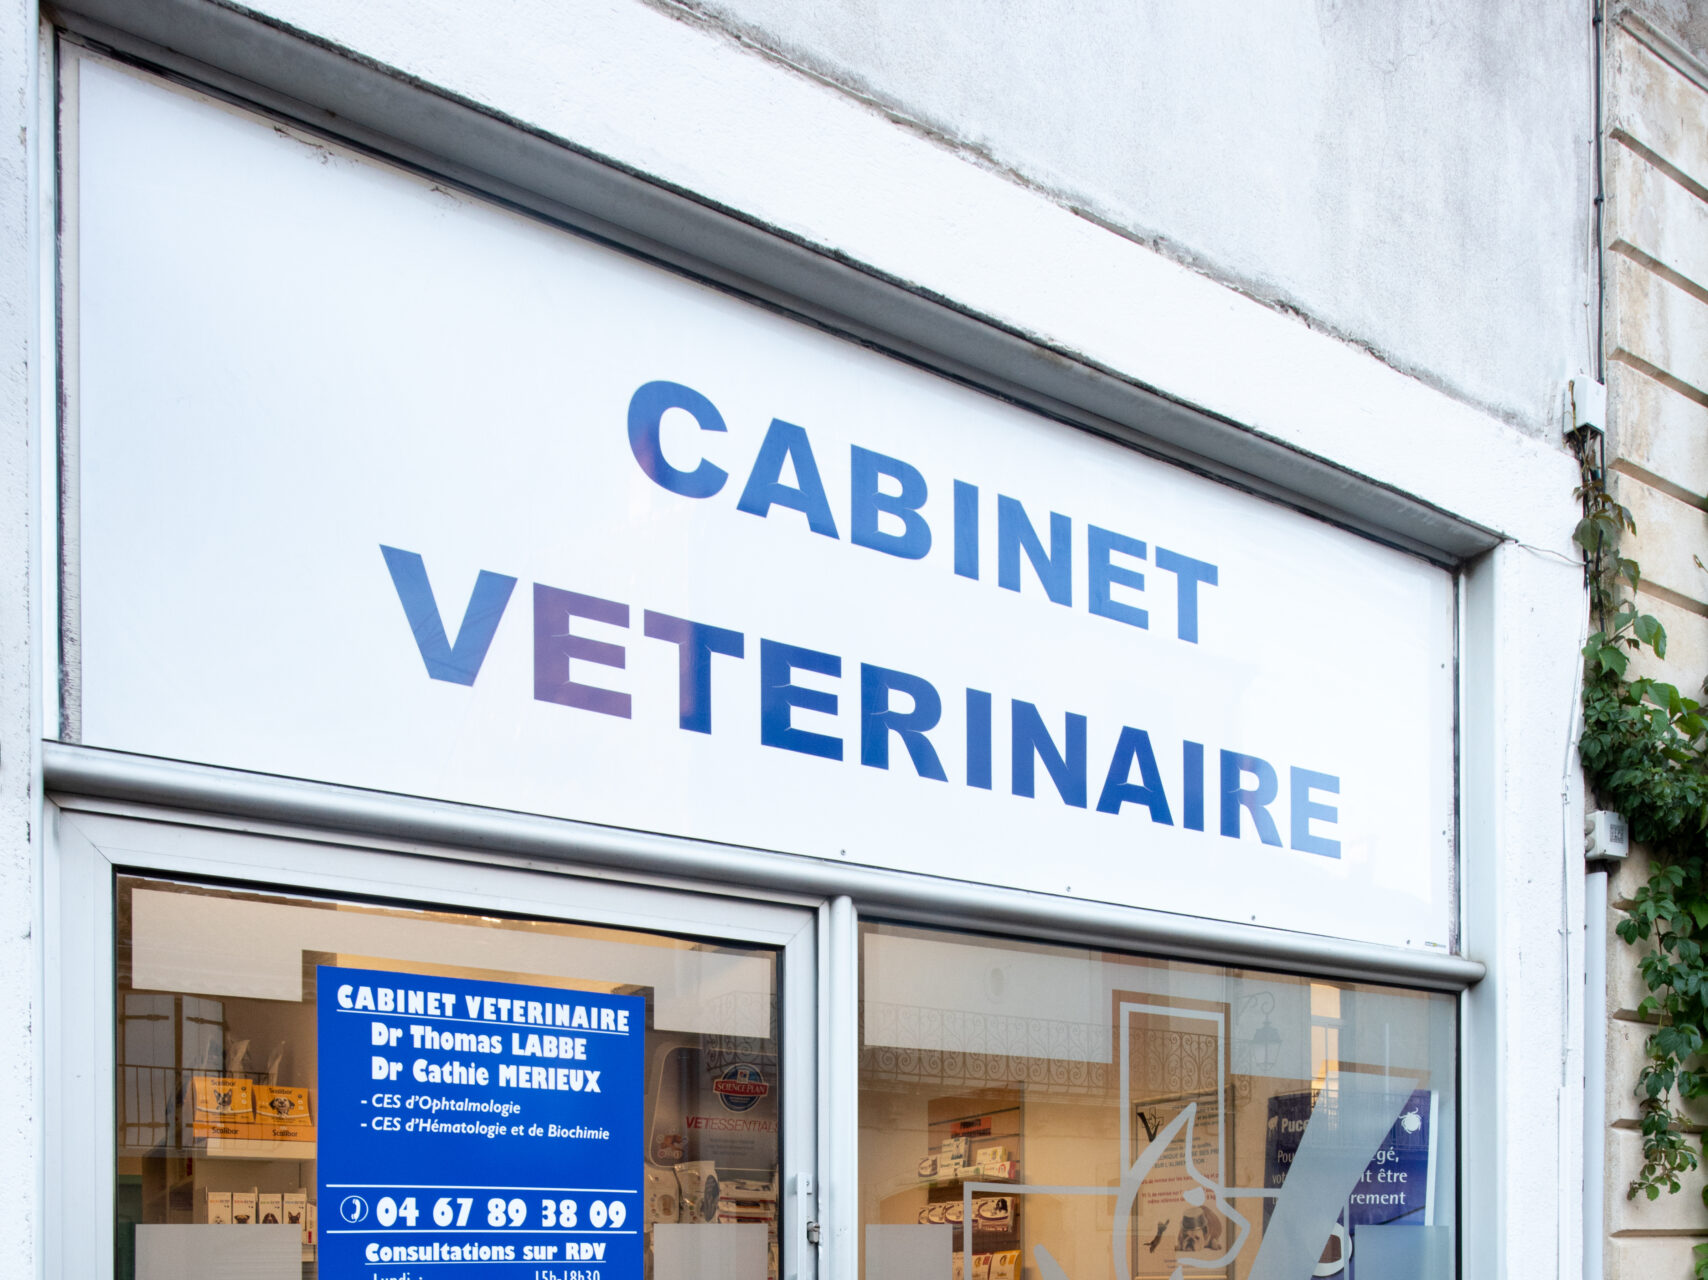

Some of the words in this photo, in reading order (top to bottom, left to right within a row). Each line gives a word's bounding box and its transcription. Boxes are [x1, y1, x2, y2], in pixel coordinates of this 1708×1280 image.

[627, 380, 1219, 644] CABINET
[379, 544, 1341, 859] VETERINAIRE
[337, 984, 456, 1017] CABINET
[465, 994, 630, 1032] VETERINAIRE
[372, 1022, 402, 1046] Dr
[410, 1025, 502, 1054] Thomas
[512, 1033, 586, 1060] LABBE
[372, 1056, 403, 1080] Dr
[413, 1059, 488, 1085] Cathie
[499, 1064, 600, 1092] MERIEUX
[745, 1085, 766, 1094] PLAN
[372, 1094, 401, 1108] CES
[406, 1096, 520, 1117] d'Ophtalmologie
[372, 1117, 401, 1131] CES
[406, 1116, 507, 1138] d'Hématologie
[511, 1125, 524, 1135] et
[528, 1124, 543, 1136] de
[548, 1124, 609, 1139] Biochimie
[1377, 1168, 1408, 1183] être
[377, 1197, 419, 1226] 04
[433, 1198, 473, 1226] 67
[488, 1198, 527, 1227] 89
[542, 1200, 577, 1227] 38
[590, 1200, 626, 1228] 09
[364, 1241, 516, 1261] Consultations
[522, 1243, 558, 1261] sur
[564, 1241, 607, 1260] RDV
